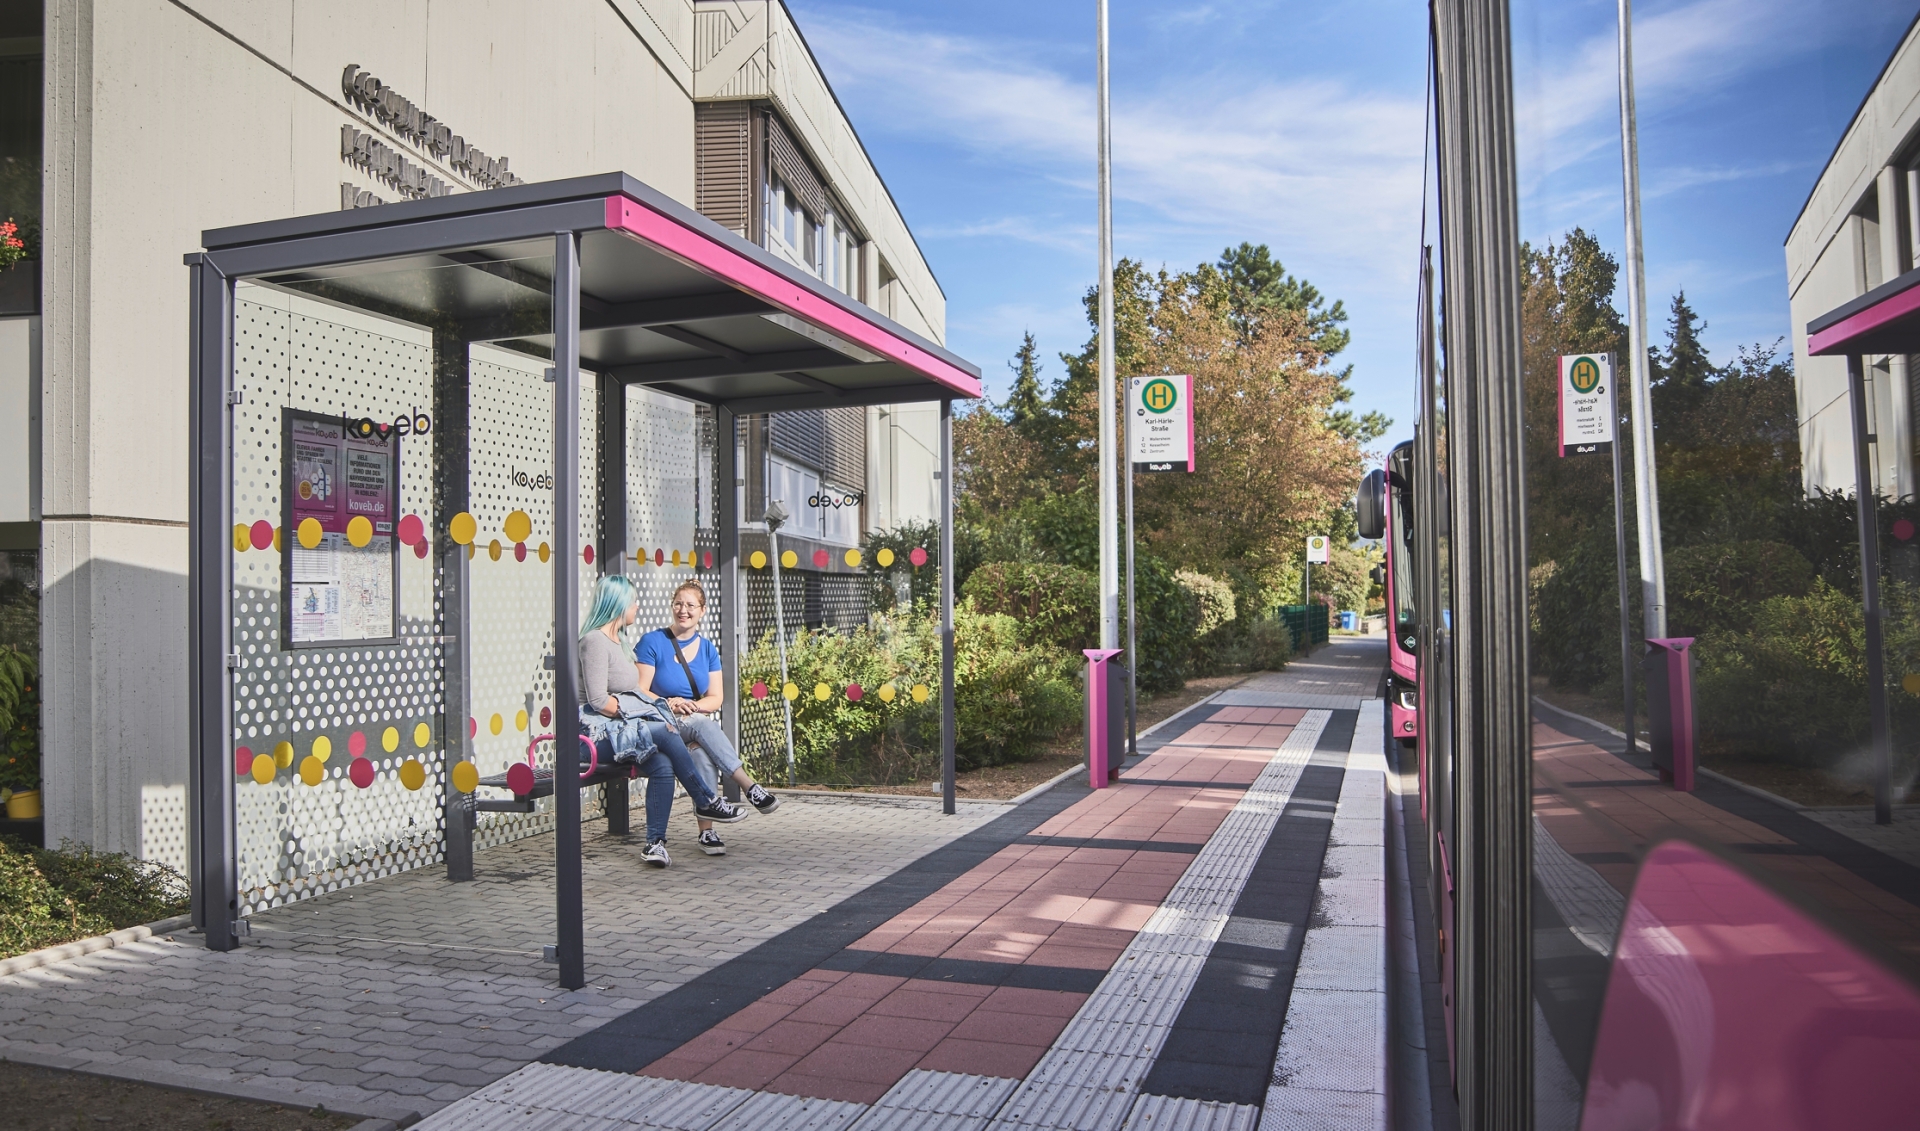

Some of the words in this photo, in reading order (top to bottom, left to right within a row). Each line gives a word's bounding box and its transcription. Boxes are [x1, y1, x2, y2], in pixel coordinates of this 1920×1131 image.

[1152, 387, 1166, 406] H
[342, 406, 430, 442] koveb
[512, 465, 553, 491] koveb
[350, 499, 384, 512] koveb.de
